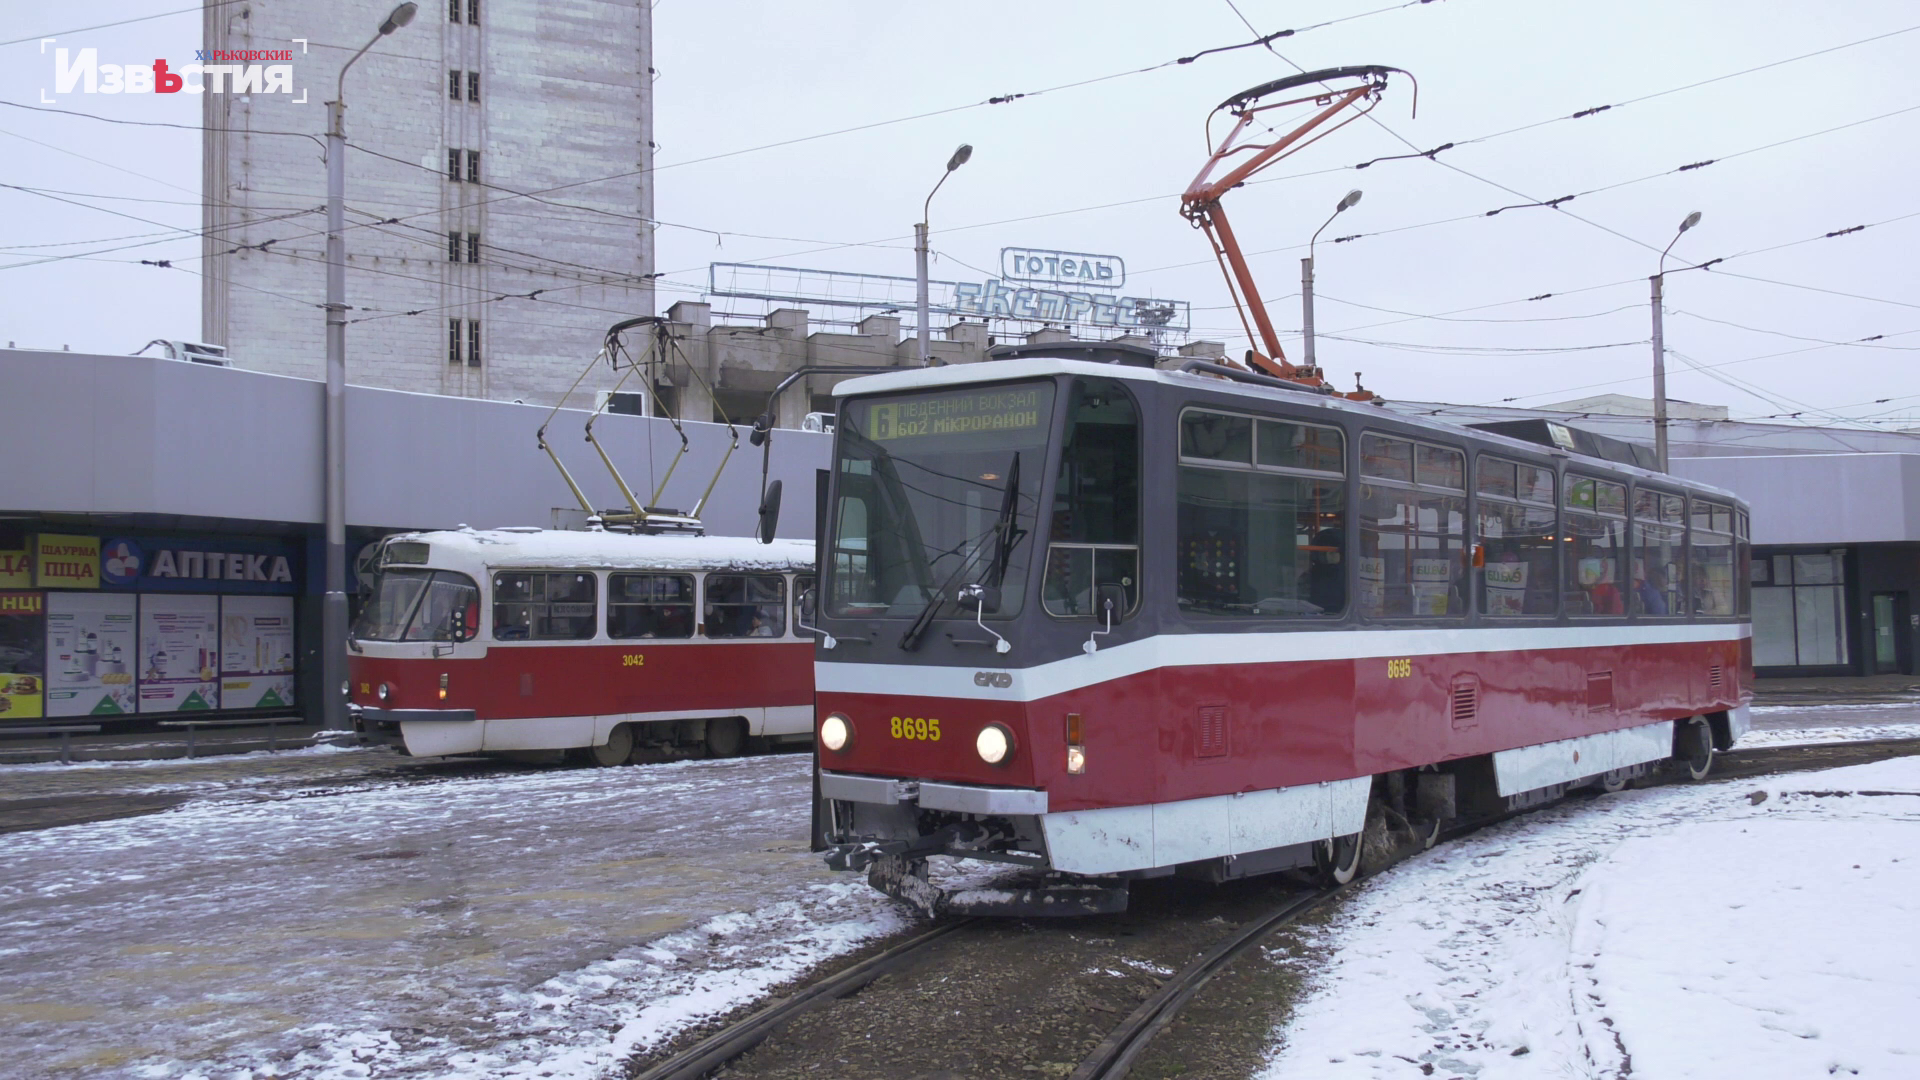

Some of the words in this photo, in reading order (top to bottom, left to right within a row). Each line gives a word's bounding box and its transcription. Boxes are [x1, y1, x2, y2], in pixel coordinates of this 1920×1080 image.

[899, 399, 973, 420] ПІВДЕННИЙ
[979, 391, 1036, 411] ВОКЗАЛ
[875, 406, 891, 439] 6
[898, 421, 928, 437] 602
[41, 544, 97, 557] ШАУРМА
[44, 561, 94, 580] ПІЦА
[152, 549, 292, 582] АПТЕКА
[622, 654, 645, 667] 3042
[1387, 658, 1411, 679] 8695
[890, 716, 941, 742] 8695
